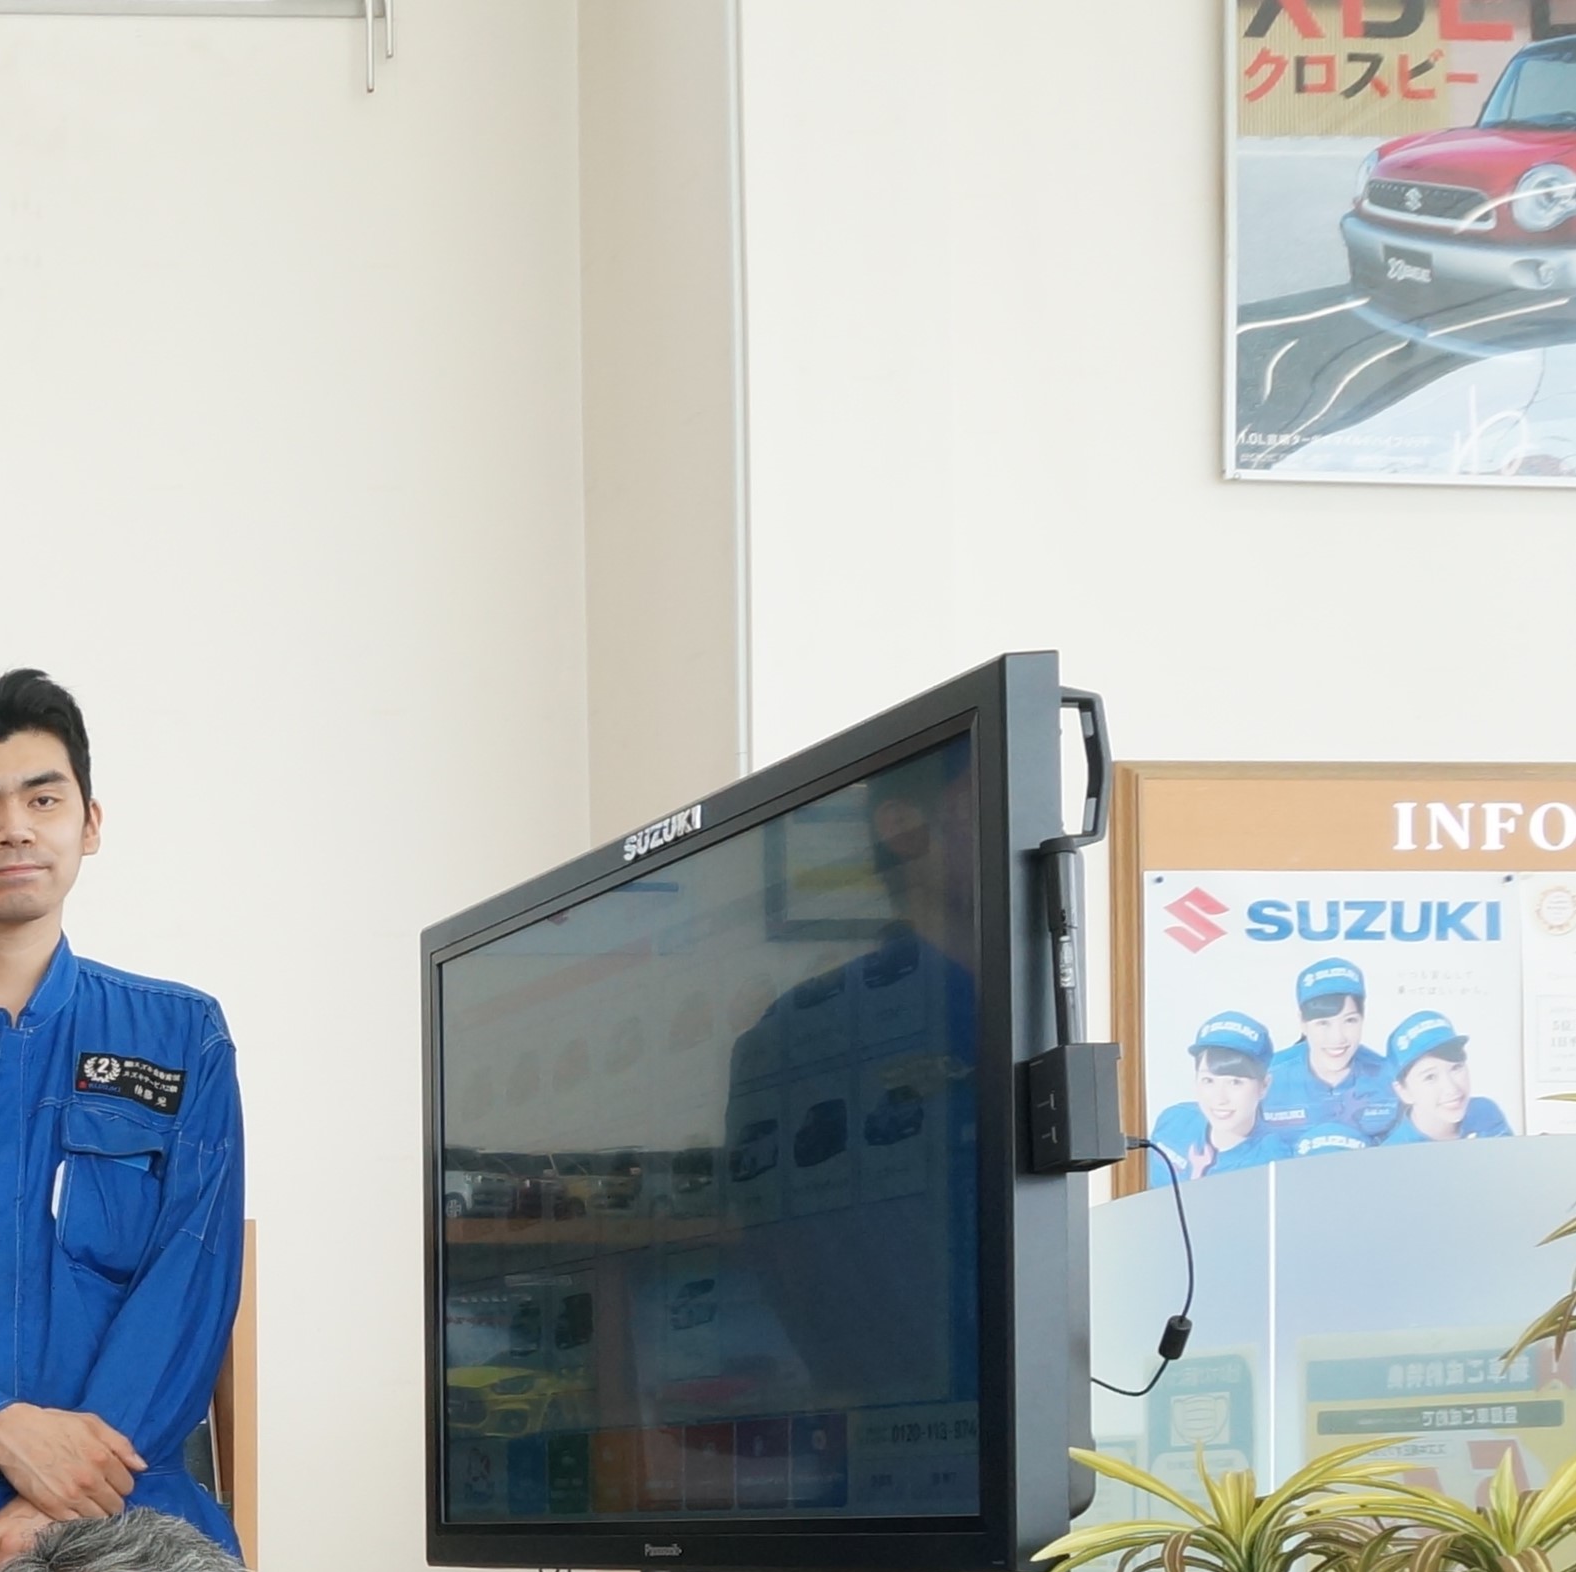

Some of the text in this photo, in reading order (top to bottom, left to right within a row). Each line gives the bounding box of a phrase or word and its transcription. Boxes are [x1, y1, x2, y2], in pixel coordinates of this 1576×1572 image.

[1244, 47, 1479, 102] クロスビー
[623, 804, 702, 861] SUZUKI
[1392, 801, 1576, 853] INFO
[1245, 899, 1502, 943] SUZUKI
[97, 1058, 110, 1074] 2
